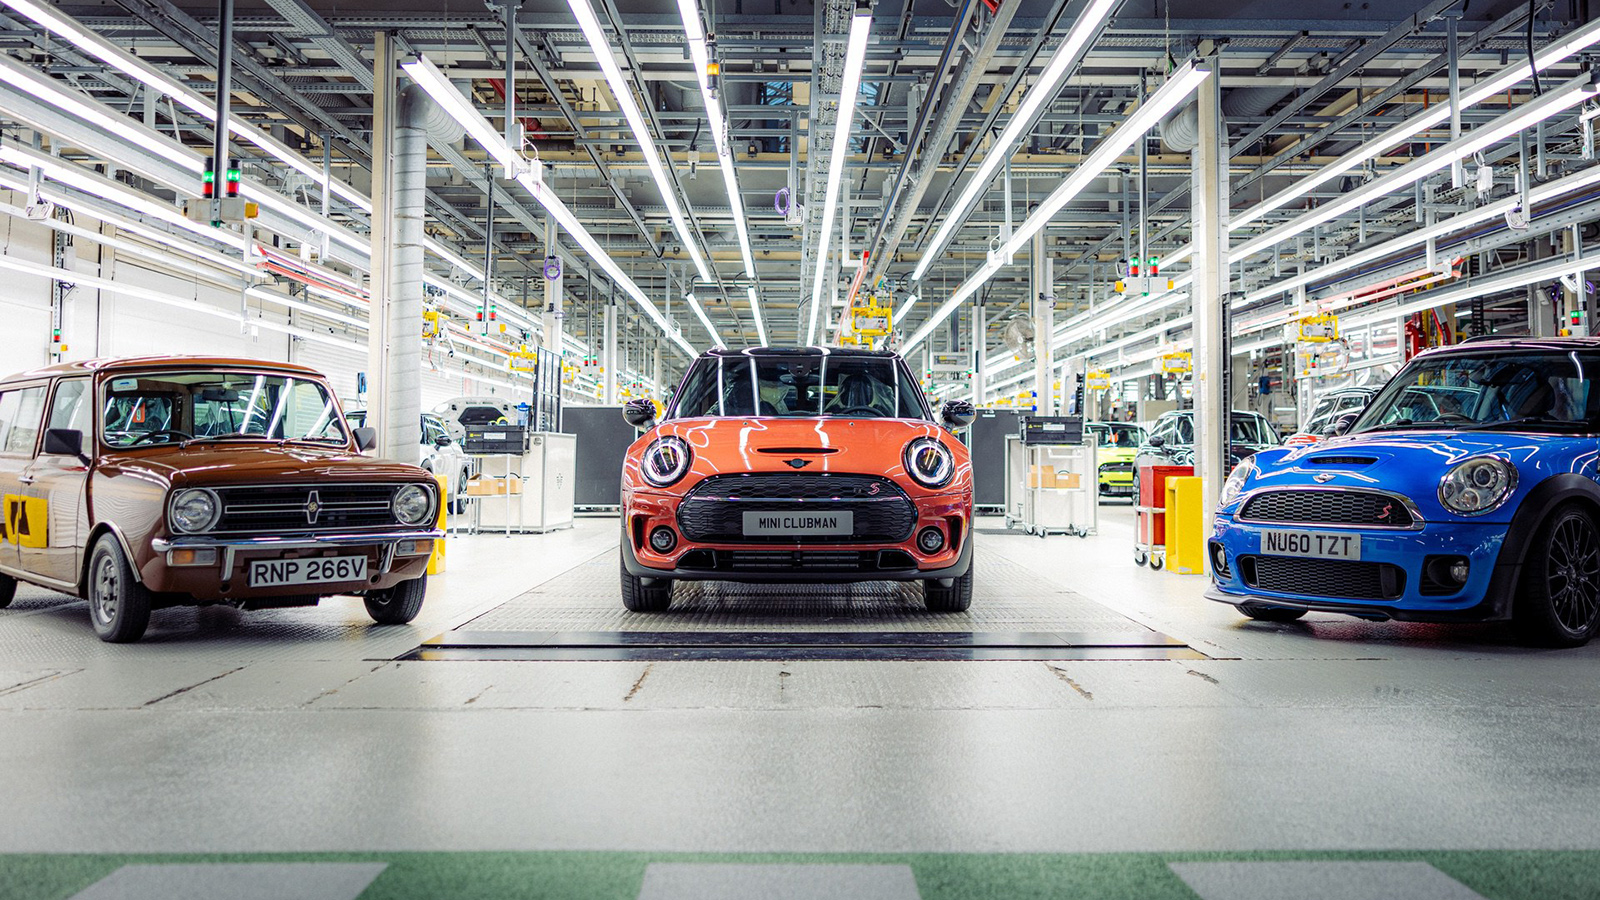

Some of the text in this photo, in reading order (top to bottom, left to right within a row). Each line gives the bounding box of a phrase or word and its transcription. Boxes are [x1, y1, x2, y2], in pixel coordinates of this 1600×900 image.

[868, 482, 881, 495] S
[759, 517, 838, 529] MINI CLUBMAN
[1267, 532, 1352, 556] NU60 TZT
[254, 558, 365, 584] RNP 266V
